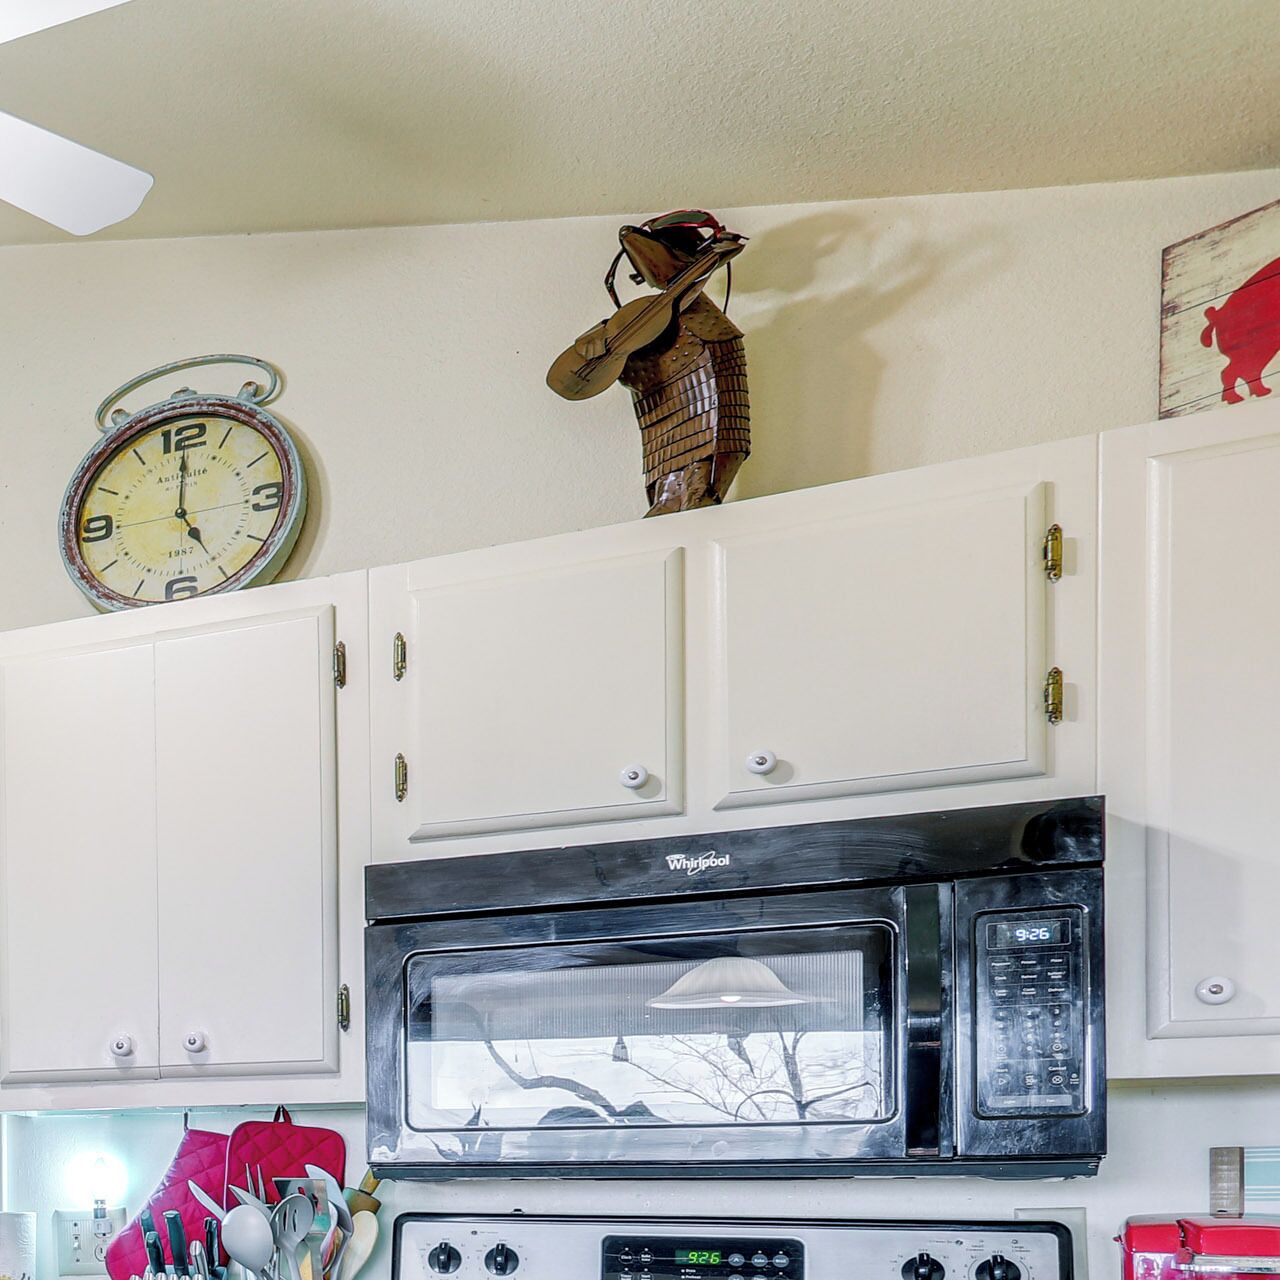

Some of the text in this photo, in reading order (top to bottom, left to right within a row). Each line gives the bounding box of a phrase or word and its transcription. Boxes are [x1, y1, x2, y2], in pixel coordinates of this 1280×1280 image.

[161, 422, 207, 454] 12
[157, 467, 208, 485] Antiuité
[251, 481, 283, 512] 3
[82, 514, 113, 544] 9
[667, 853, 730, 872] Whirlpool
[1015, 927, 1050, 941] 9:26
[688, 1251, 720, 1265] 9:26
